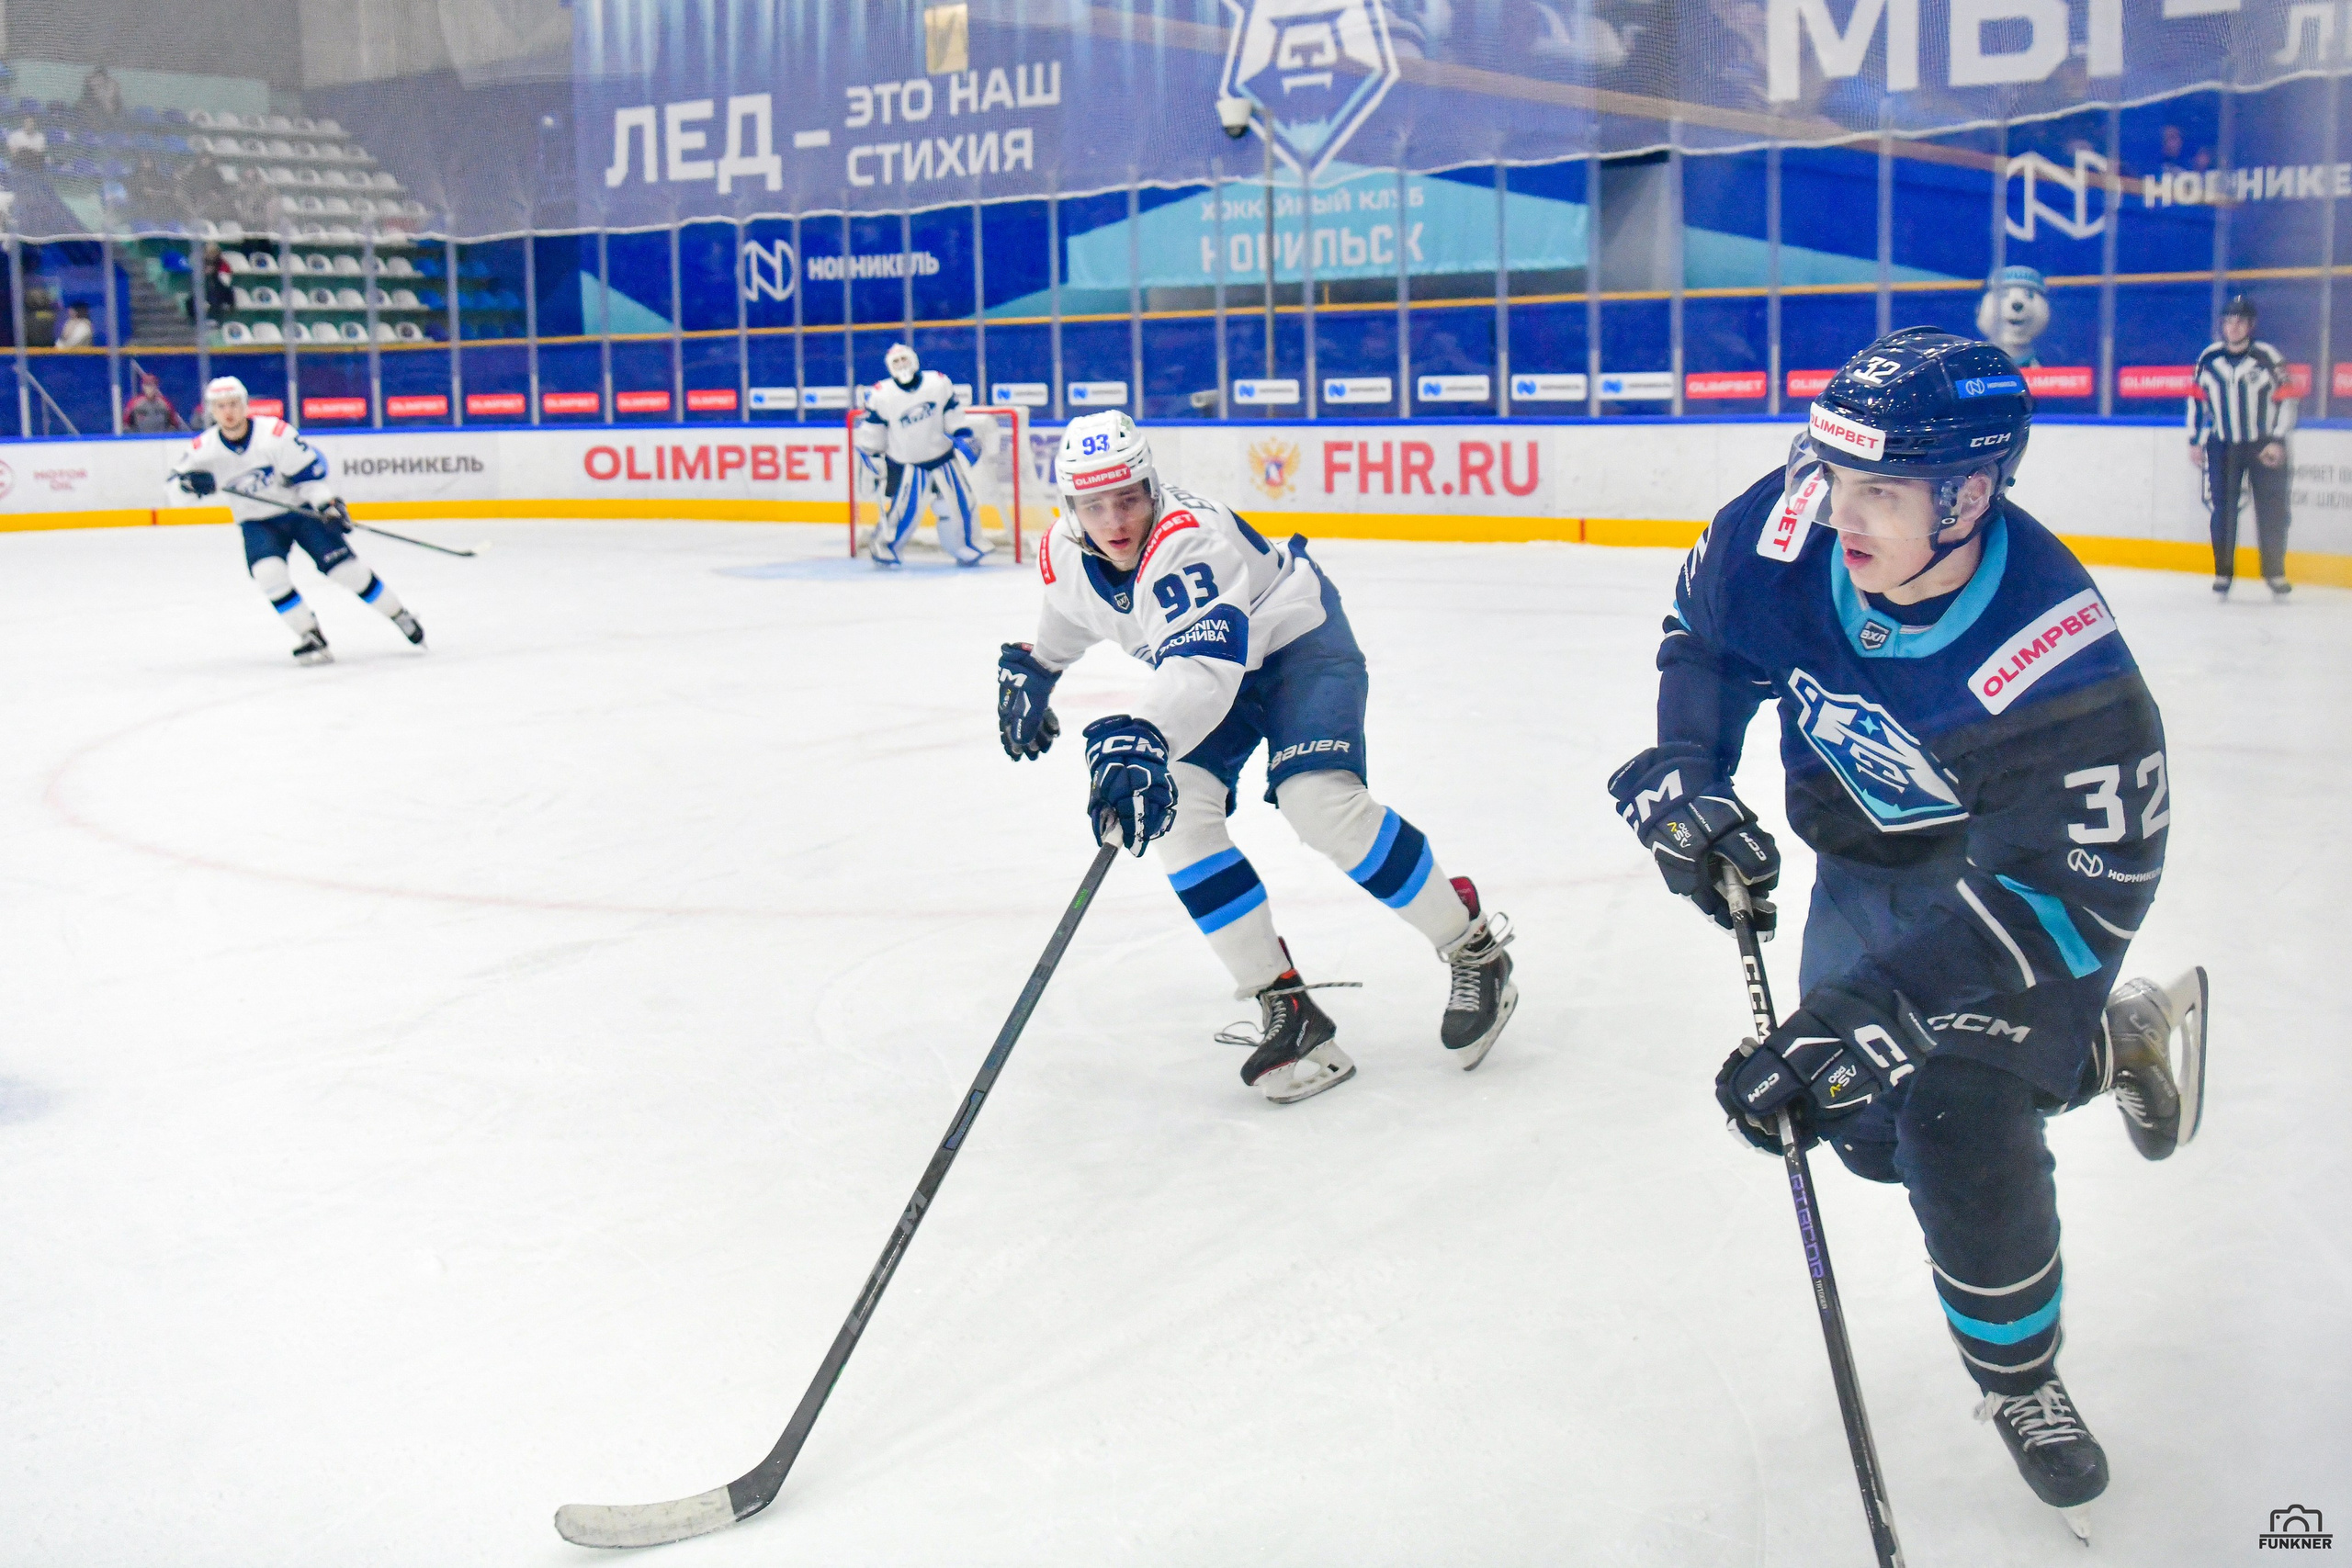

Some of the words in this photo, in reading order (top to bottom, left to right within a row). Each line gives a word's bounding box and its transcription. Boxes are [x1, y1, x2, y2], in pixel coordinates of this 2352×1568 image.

[844, 78, 933, 128] ЭТО
[947, 61, 1062, 116] НАШ
[605, 93, 783, 194] ЛЕД
[845, 128, 1035, 186] СТИХИЯ
[1201, 187, 1352, 221] ХОККЙЫЙ
[1852, 355, 1901, 385] 32
[1081, 434, 1111, 456] 93
[1809, 412, 1880, 450] OLIMPBET
[1969, 432, 2012, 448] CCM
[344, 456, 484, 477] НОРНИКЕЛЬ
[583, 444, 842, 481] OLIMPBET
[1075, 467, 1128, 486] OLIMPBET
[1322, 440, 1541, 496] FHR.RU
[1137, 513, 1193, 579] IMPBET
[1152, 561, 1220, 624] 93
[1983, 602, 2104, 697] OLIMPBET
[1087, 735, 1165, 770] CCM
[2064, 750, 2171, 844] 32
[1742, 955, 1771, 1045] CCM
[1927, 1012, 2032, 1043] CCM
